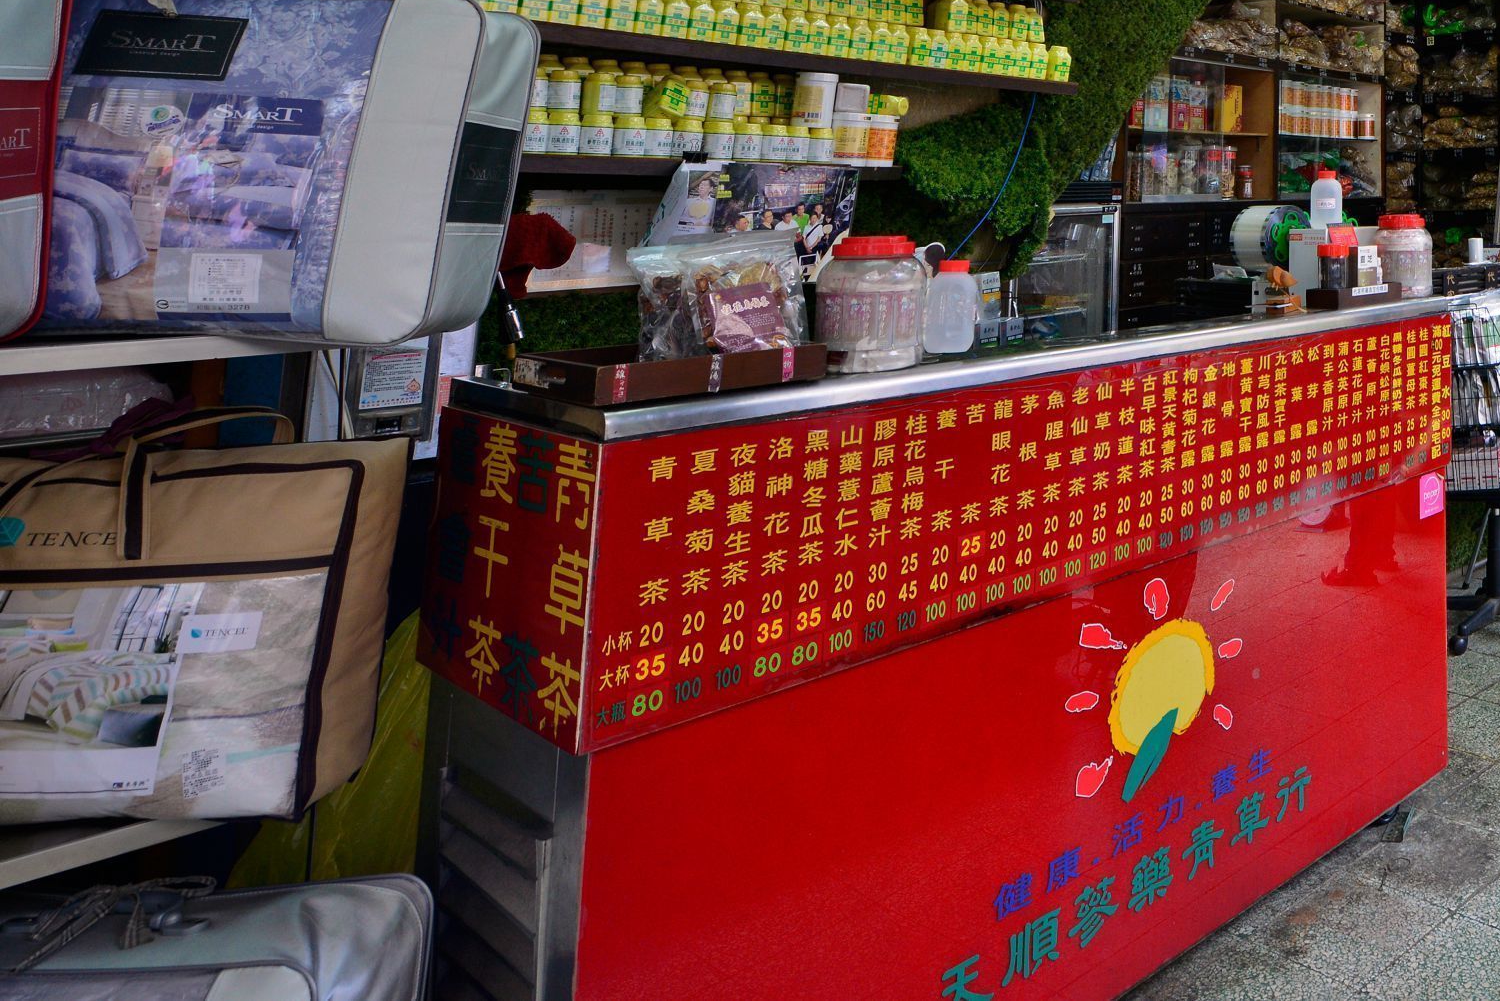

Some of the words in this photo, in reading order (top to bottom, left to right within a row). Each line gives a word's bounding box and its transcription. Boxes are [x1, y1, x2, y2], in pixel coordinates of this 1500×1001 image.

[899, 414, 927, 540] 桂花烏梅茶
[960, 403, 986, 524] 苦茶
[989, 400, 1013, 517] 龍眼花茶
[1016, 395, 1039, 510] 茅根茶
[1043, 390, 1065, 503] 魚腥草茶
[1068, 387, 1089, 497] 老仙草茶
[1092, 382, 1112, 491] 仙草奶茶
[1117, 379, 1135, 484] 半枝蓮茶
[1139, 375, 1157, 478] 古早味紅茶
[1201, 365, 1218, 463] 金銀花露
[26, 530, 117, 547] TENCE
[602, 631, 632, 656] 小杯
[640, 622, 664, 647] 20
[682, 611, 705, 636] 20
[723, 601, 745, 624] 20
[762, 590, 783, 613] 20
[799, 580, 818, 602] 20
[835, 571, 854, 592] 20
[868, 562, 887, 583] 30
[901, 553, 918, 574] 25
[932, 545, 949, 565] 20
[961, 536, 980, 556] 25
[990, 530, 1005, 549] 20
[1018, 524, 1032, 542] 20
[1044, 516, 1059, 534] 20
[1069, 509, 1083, 527] 20
[1093, 502, 1106, 520] 25
[1118, 496, 1130, 513] 20
[1140, 490, 1152, 507] 20
[1161, 484, 1173, 501] 25
[1182, 479, 1193, 495] 30
[1202, 473, 1213, 489] 30
[1221, 468, 1232, 484] 30
[1240, 463, 1250, 479] 30
[1257, 459, 1268, 474] 30
[1275, 454, 1285, 469] 30
[1291, 450, 1300, 464] 30
[1307, 445, 1316, 459] 50
[639, 456, 677, 605] 青草茶
[681, 448, 719, 596] 夏桑菊茶
[721, 443, 758, 587] 夜貓養生茶
[761, 436, 794, 576] 洛神花茶
[798, 430, 829, 565] 黑糖冬瓜茶
[834, 425, 863, 556] 山藥薏仁水
[538, 440, 597, 739] 青草茶
[599, 664, 629, 691] 大杯
[635, 654, 666, 680] 35
[678, 642, 704, 666] 40
[719, 631, 744, 655] 40
[756, 619, 783, 643] 35
[797, 608, 822, 632] 35
[832, 599, 853, 622] 40
[866, 590, 886, 612] 60
[899, 579, 918, 602] 45
[930, 571, 949, 592] 40
[959, 562, 977, 583] 40
[988, 555, 1005, 575] 40
[1016, 548, 1032, 566] 40
[1043, 540, 1058, 558] 40
[1068, 533, 1082, 552] 40
[1092, 526, 1106, 544] 50
[1116, 519, 1130, 536] 40
[1139, 513, 1152, 530] 40
[1160, 507, 1173, 523] 50
[1181, 501, 1193, 517] 60
[1201, 495, 1212, 511] 60
[1220, 489, 1231, 505] 60
[632, 689, 664, 717] 80
[675, 677, 701, 704] 100
[715, 665, 741, 690] 100
[754, 653, 781, 677] 80
[792, 641, 818, 666] 80
[829, 629, 853, 652] 100
[925, 601, 946, 622] 100
[956, 591, 976, 612] 100
[986, 582, 1004, 603] 100
[1013, 574, 1031, 594] 100
[1039, 566, 1056, 586] 100
[1064, 559, 1081, 577] 100
[1114, 543, 1129, 561] 100
[1137, 536, 1152, 553] 100
